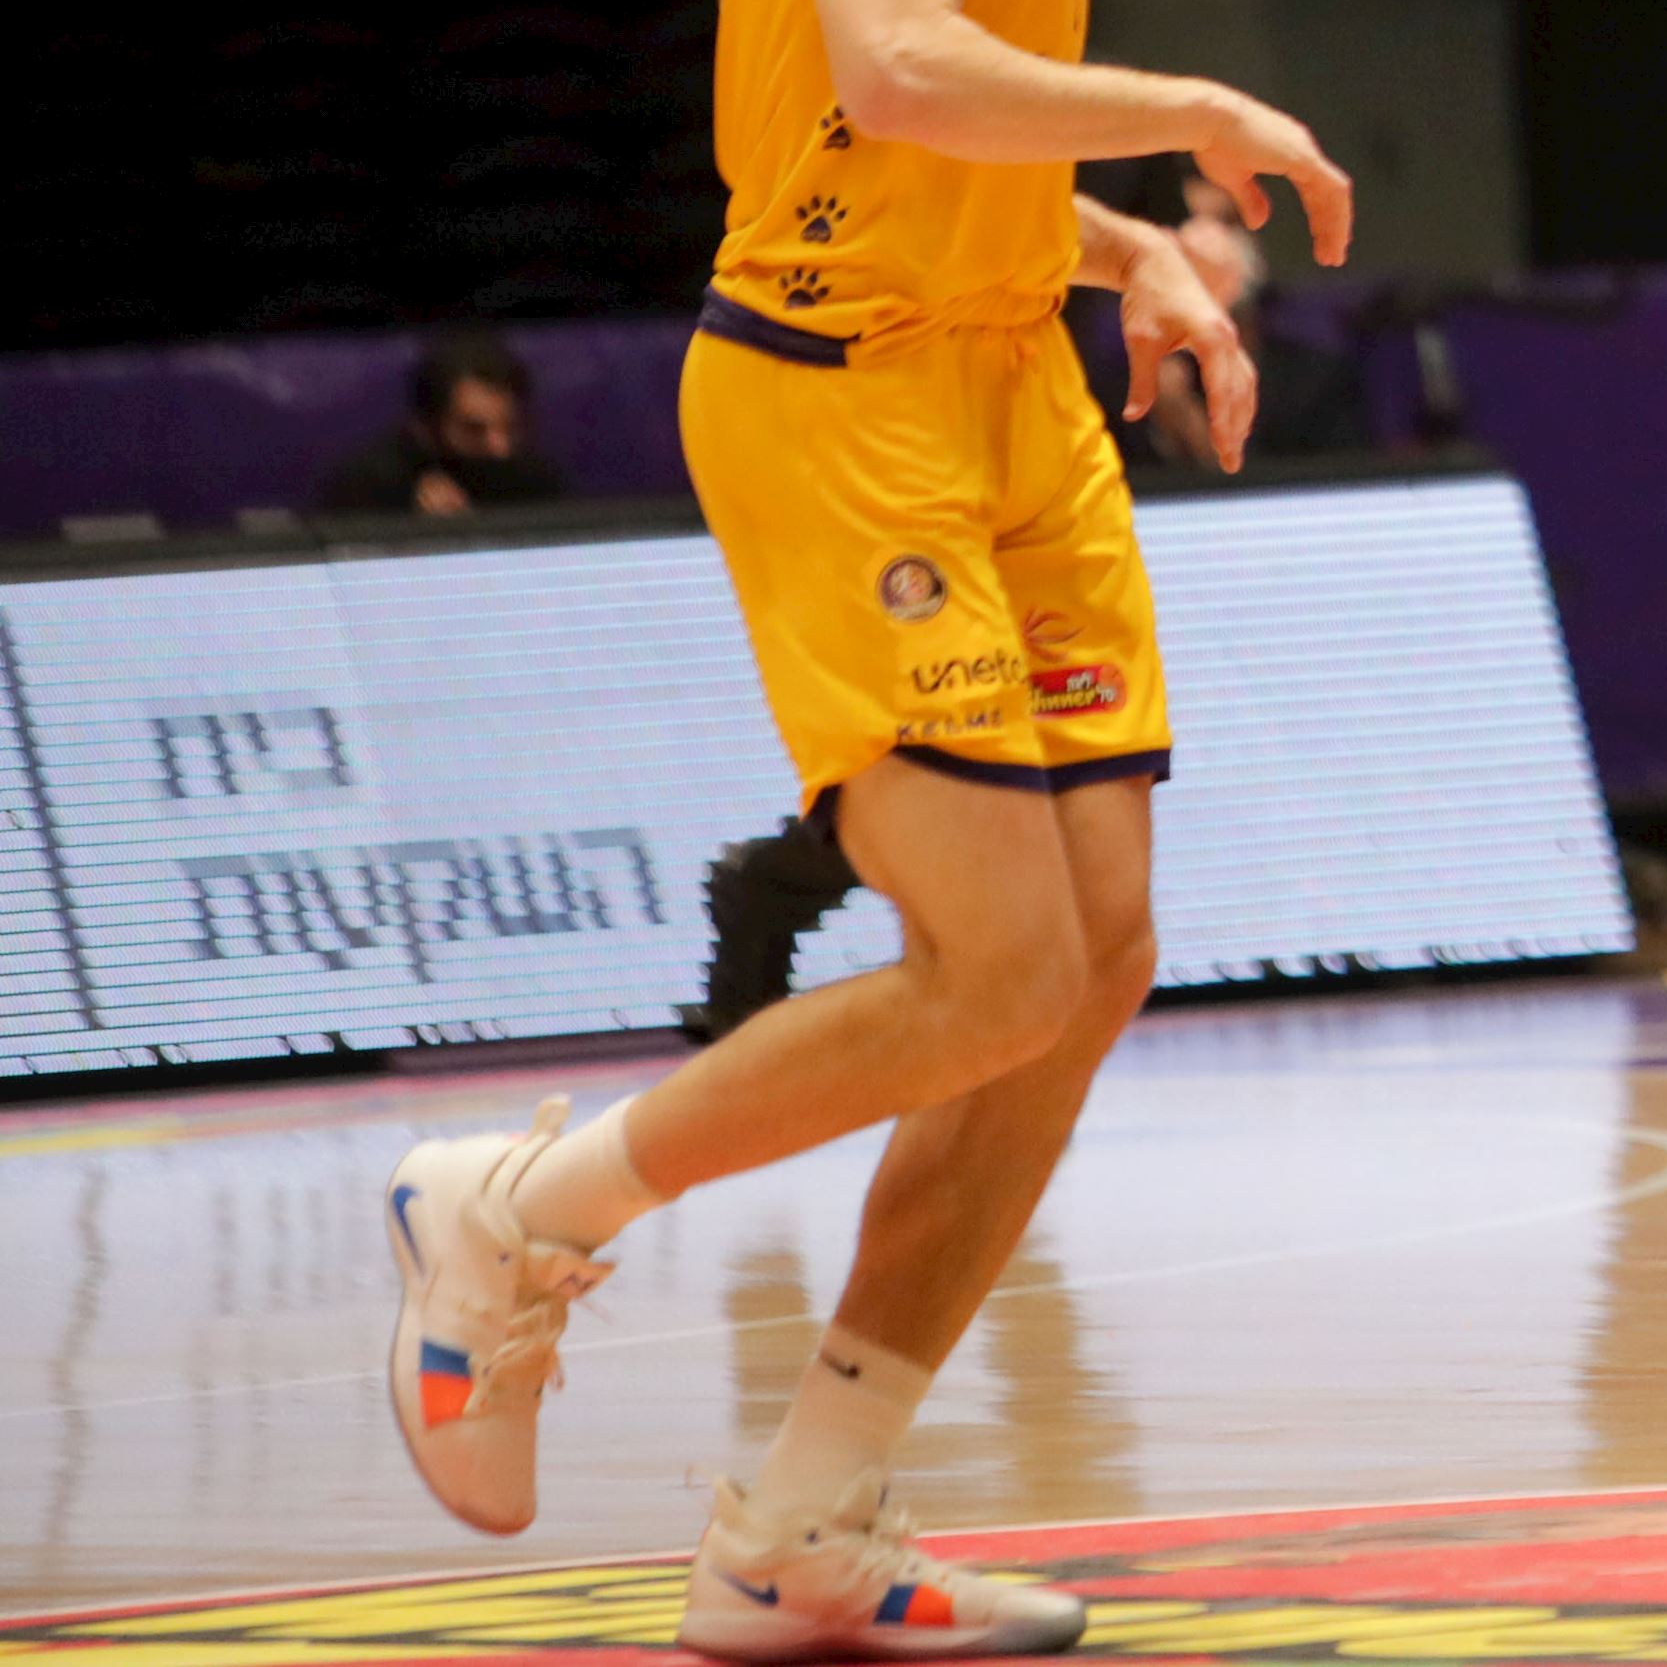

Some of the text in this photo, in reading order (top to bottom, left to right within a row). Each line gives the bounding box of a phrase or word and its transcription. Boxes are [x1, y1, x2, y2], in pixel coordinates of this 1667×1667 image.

[1032, 686, 1096, 715] inner
[150, 704, 354, 801] בית
[178, 822, 668, 987] השקעות
